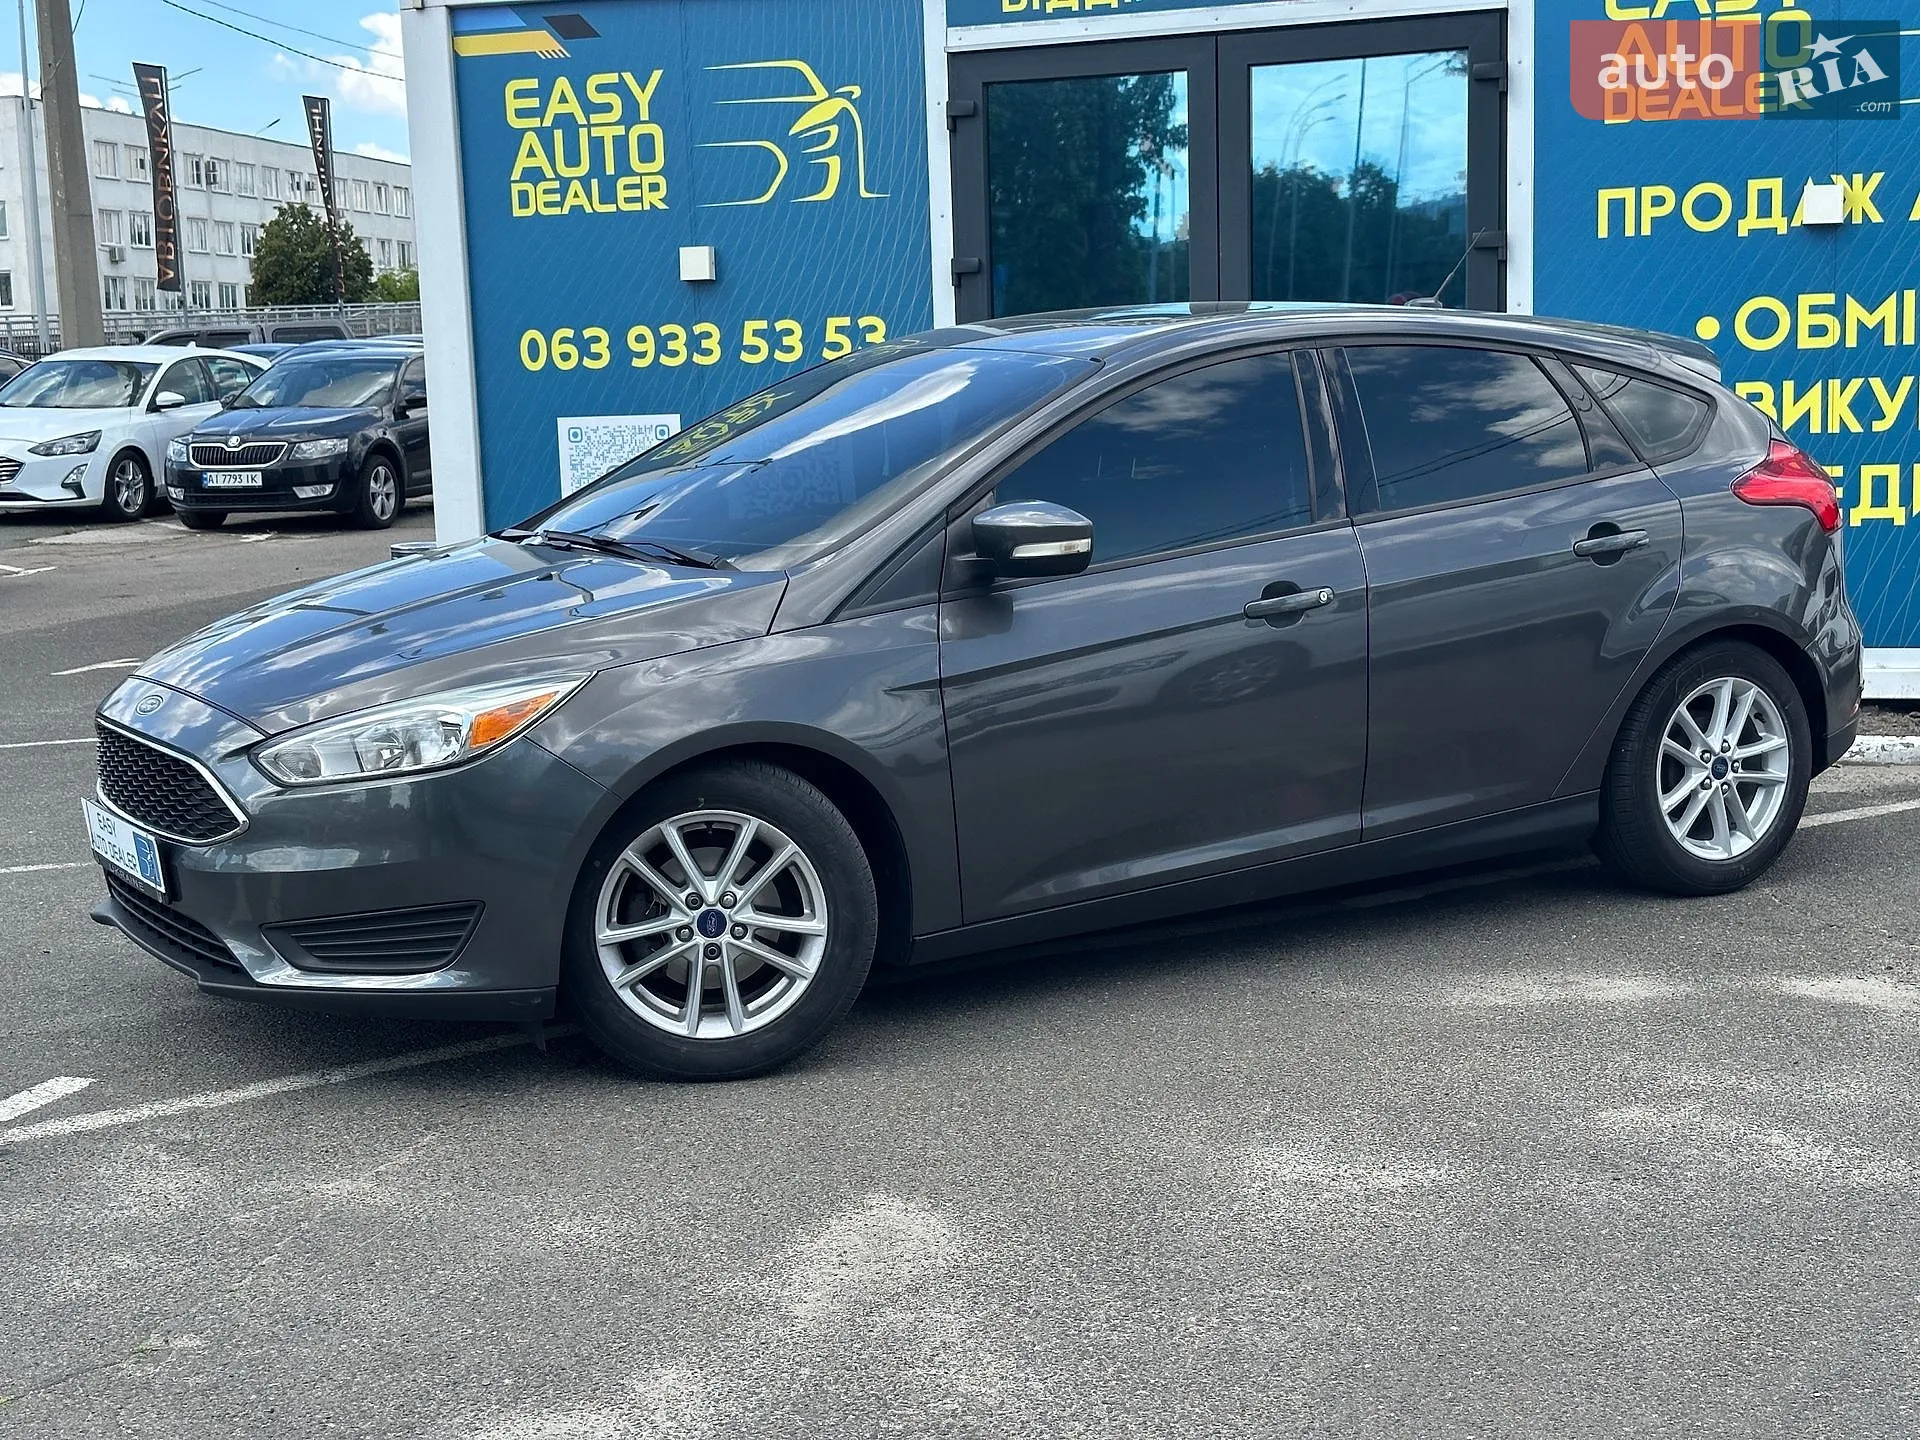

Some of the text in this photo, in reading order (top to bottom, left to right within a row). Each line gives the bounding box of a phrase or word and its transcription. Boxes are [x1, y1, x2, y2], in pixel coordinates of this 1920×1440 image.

[1609, 9, 1813, 80] AUTO
[505, 69, 665, 129] EASY
[511, 123, 666, 181] AUTO
[511, 175, 669, 218] DEALER
[520, 325, 610, 371] 063
[626, 322, 721, 369] 933
[740, 317, 803, 364] 53
[822, 315, 887, 361] 53
[1735, 375, 1920, 434] ВИКУ
[208, 473, 219, 484] AI
[221, 473, 243, 484] 7793
[246, 473, 258, 484] IK
[96, 812, 117, 838] EASY
[107, 841, 139, 875] DEALER
